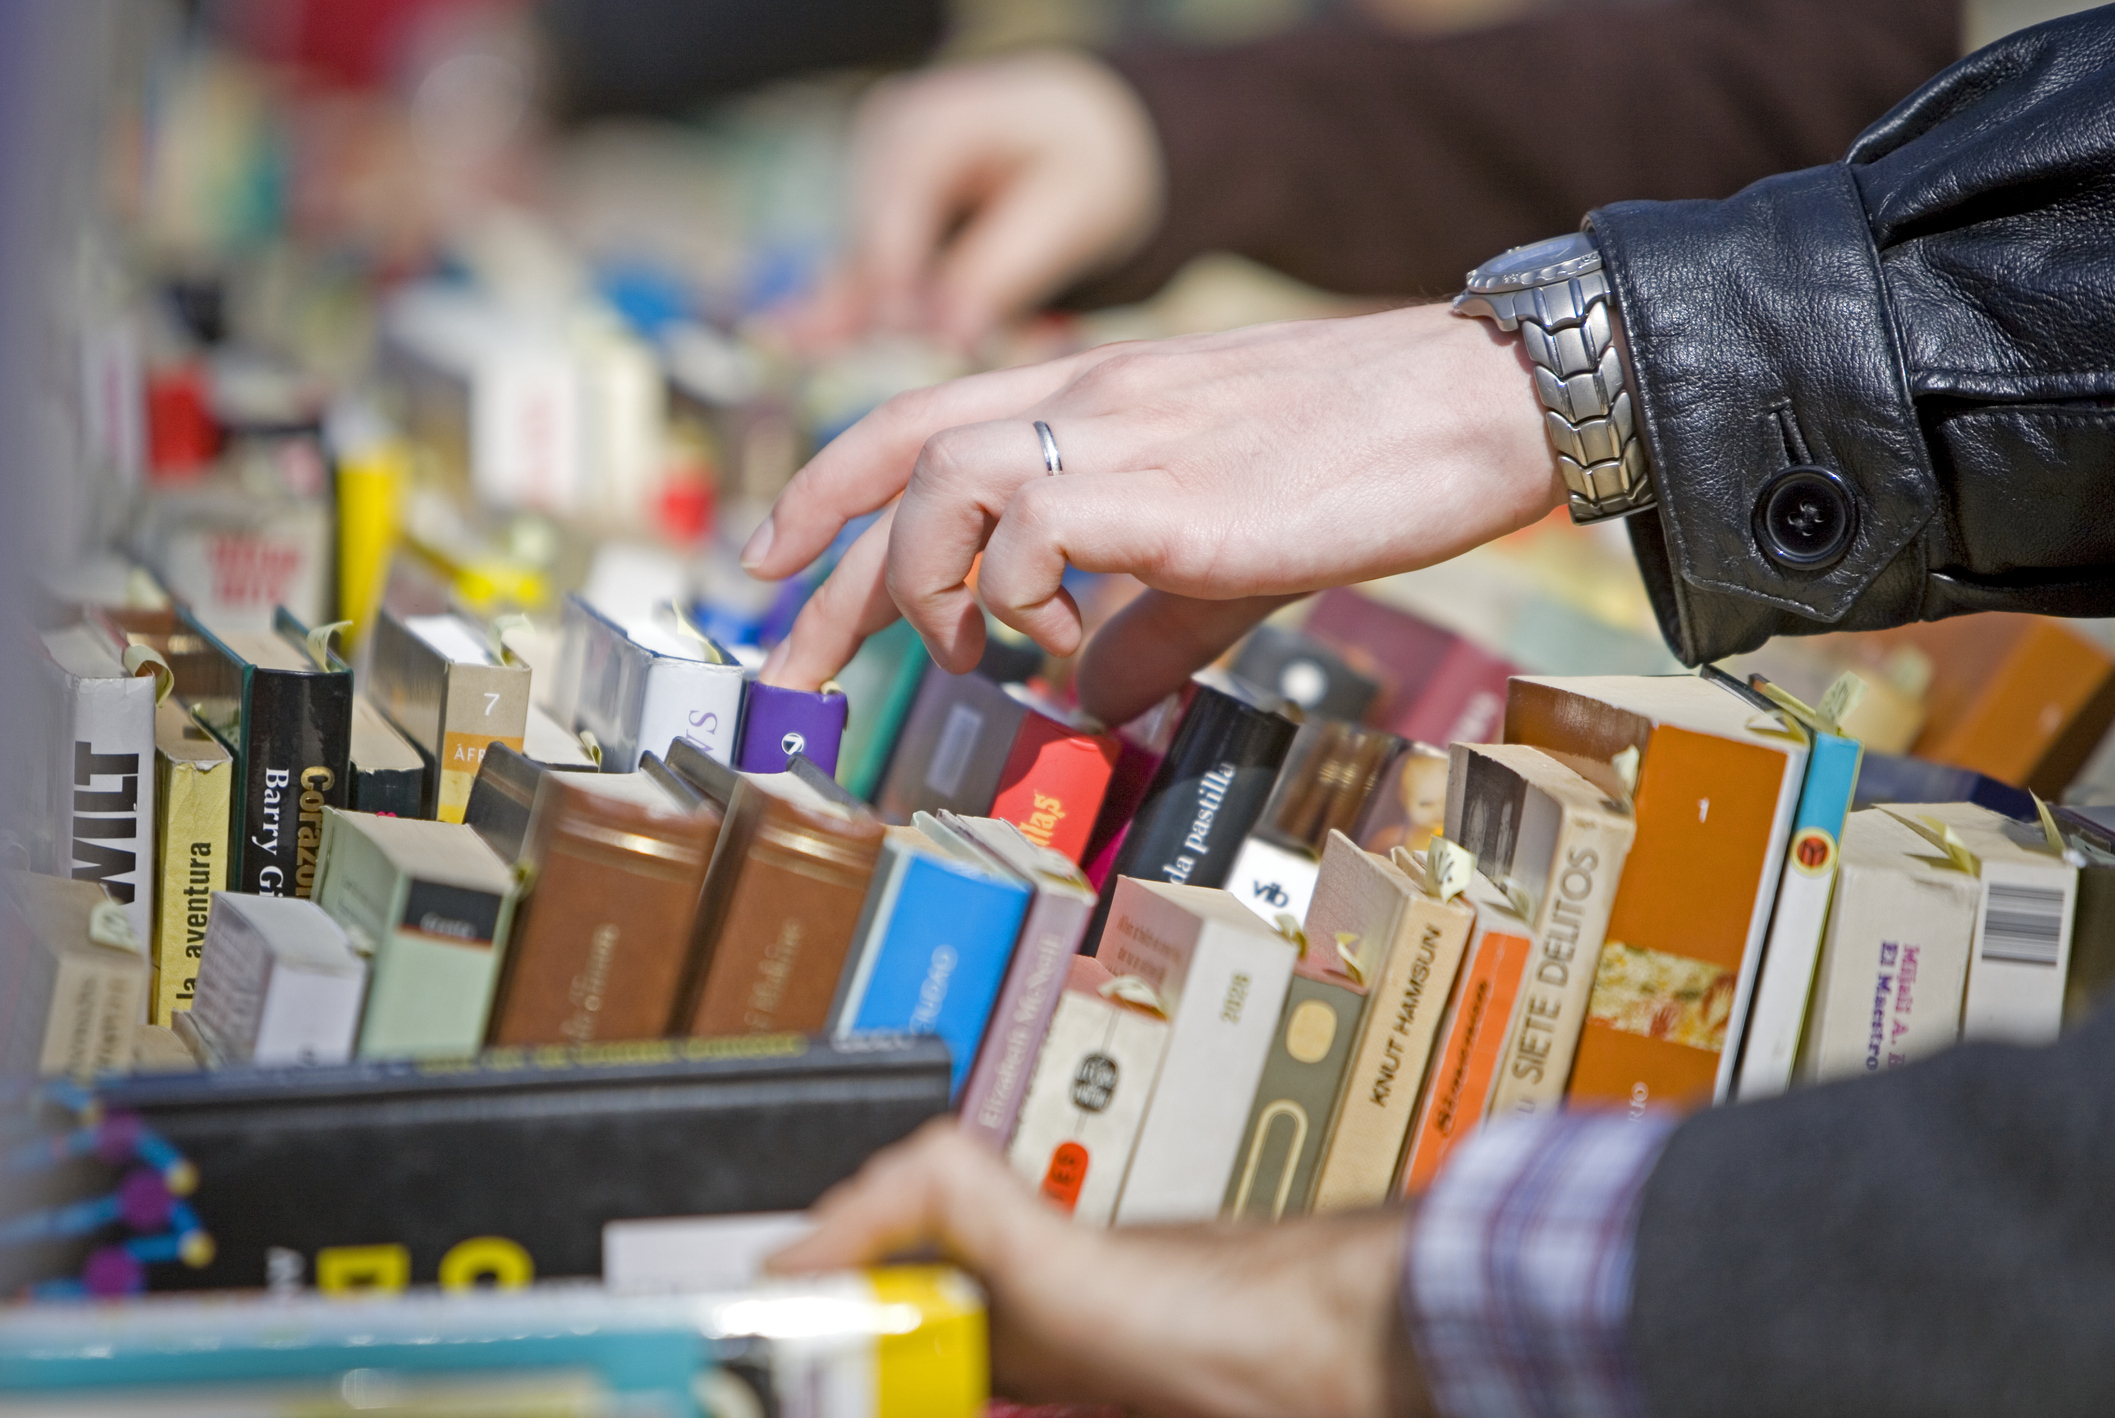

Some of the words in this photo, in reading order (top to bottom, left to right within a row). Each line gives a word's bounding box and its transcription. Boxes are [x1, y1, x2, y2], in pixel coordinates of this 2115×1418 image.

[484, 692, 499, 716] 7
[71, 741, 139, 905] WILT
[252, 767, 290, 856] Barry
[1184, 762, 1236, 854] pastilla
[183, 842, 212, 959] aventura
[1536, 847, 1599, 988] DELITOS
[176, 977, 197, 1000] la
[1370, 1035, 1404, 1108] KNUT
[1393, 922, 1442, 1036] HAMSUN
[1866, 973, 1893, 1071] Maestro
[978, 1026, 1033, 1129] Elizabeth
[1512, 996, 1561, 1085] SIETE
